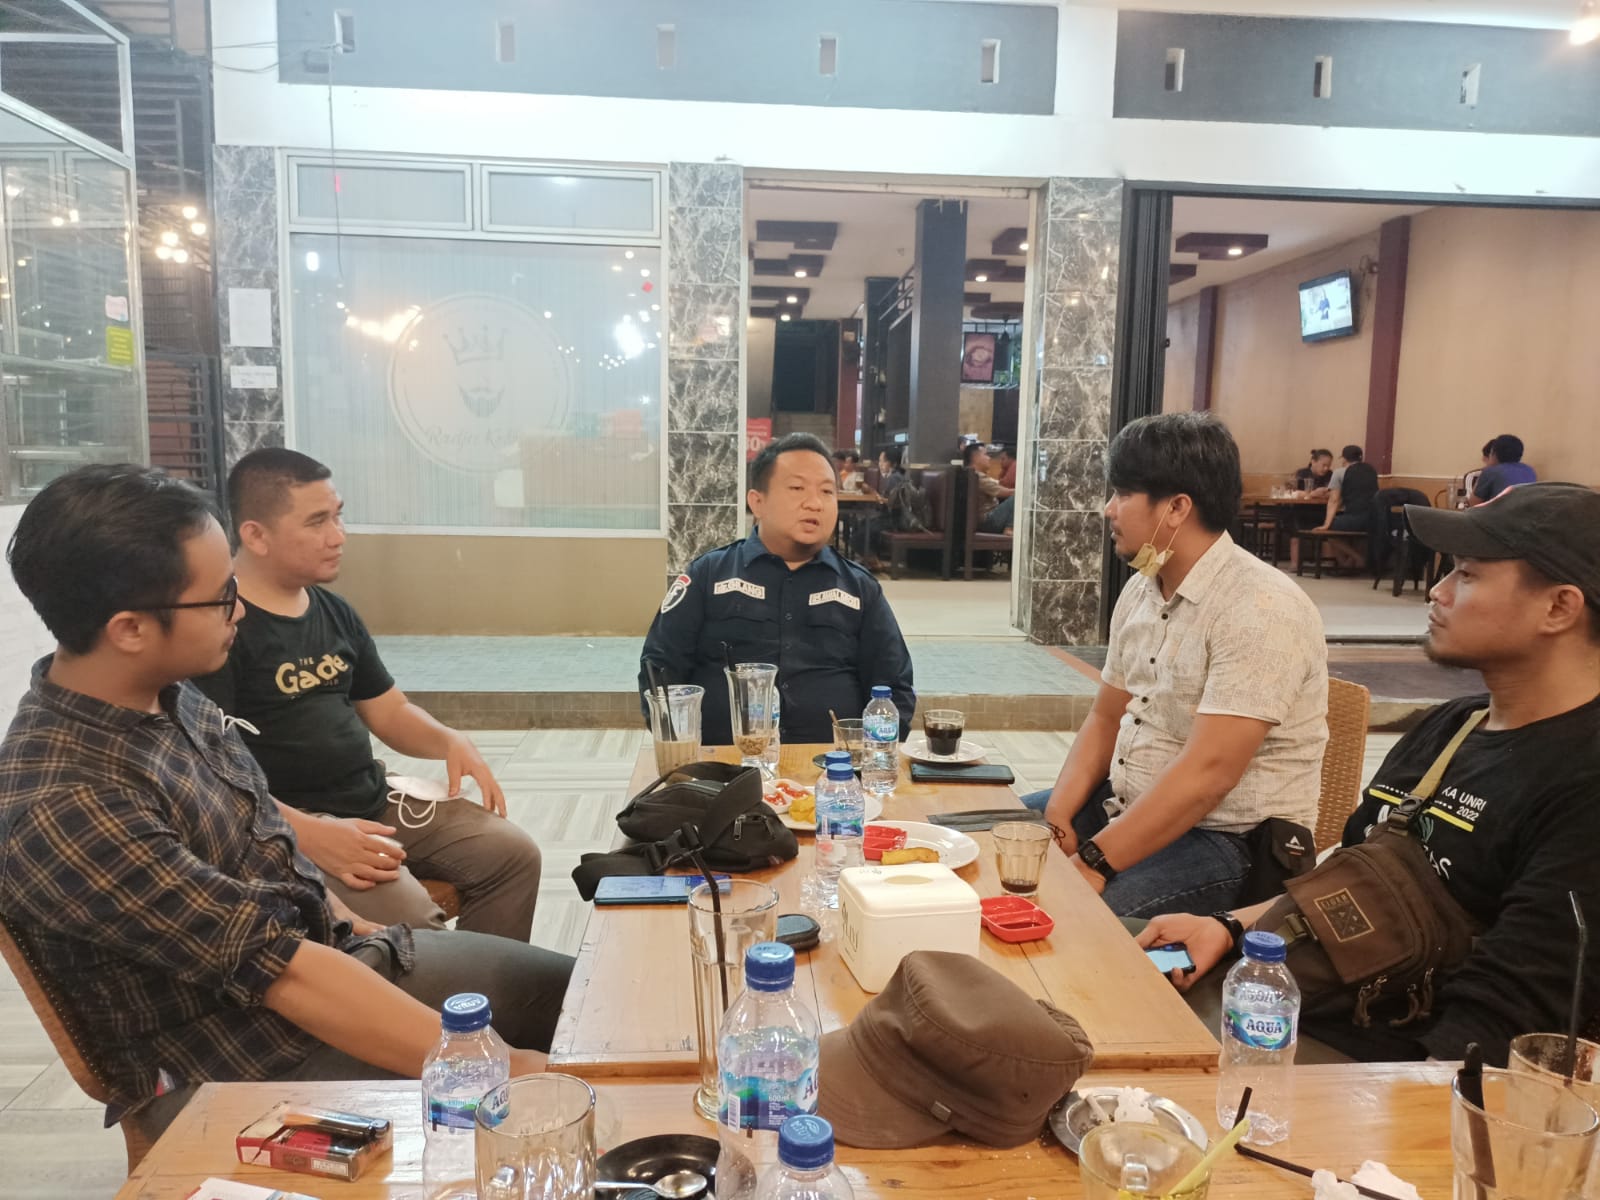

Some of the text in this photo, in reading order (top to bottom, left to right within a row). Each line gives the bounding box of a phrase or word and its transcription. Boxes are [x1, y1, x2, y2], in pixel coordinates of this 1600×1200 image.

[1459, 792, 1487, 811] UNRI
[1456, 806, 1479, 822] 2022
[1246, 1018, 1282, 1036] AQUA
